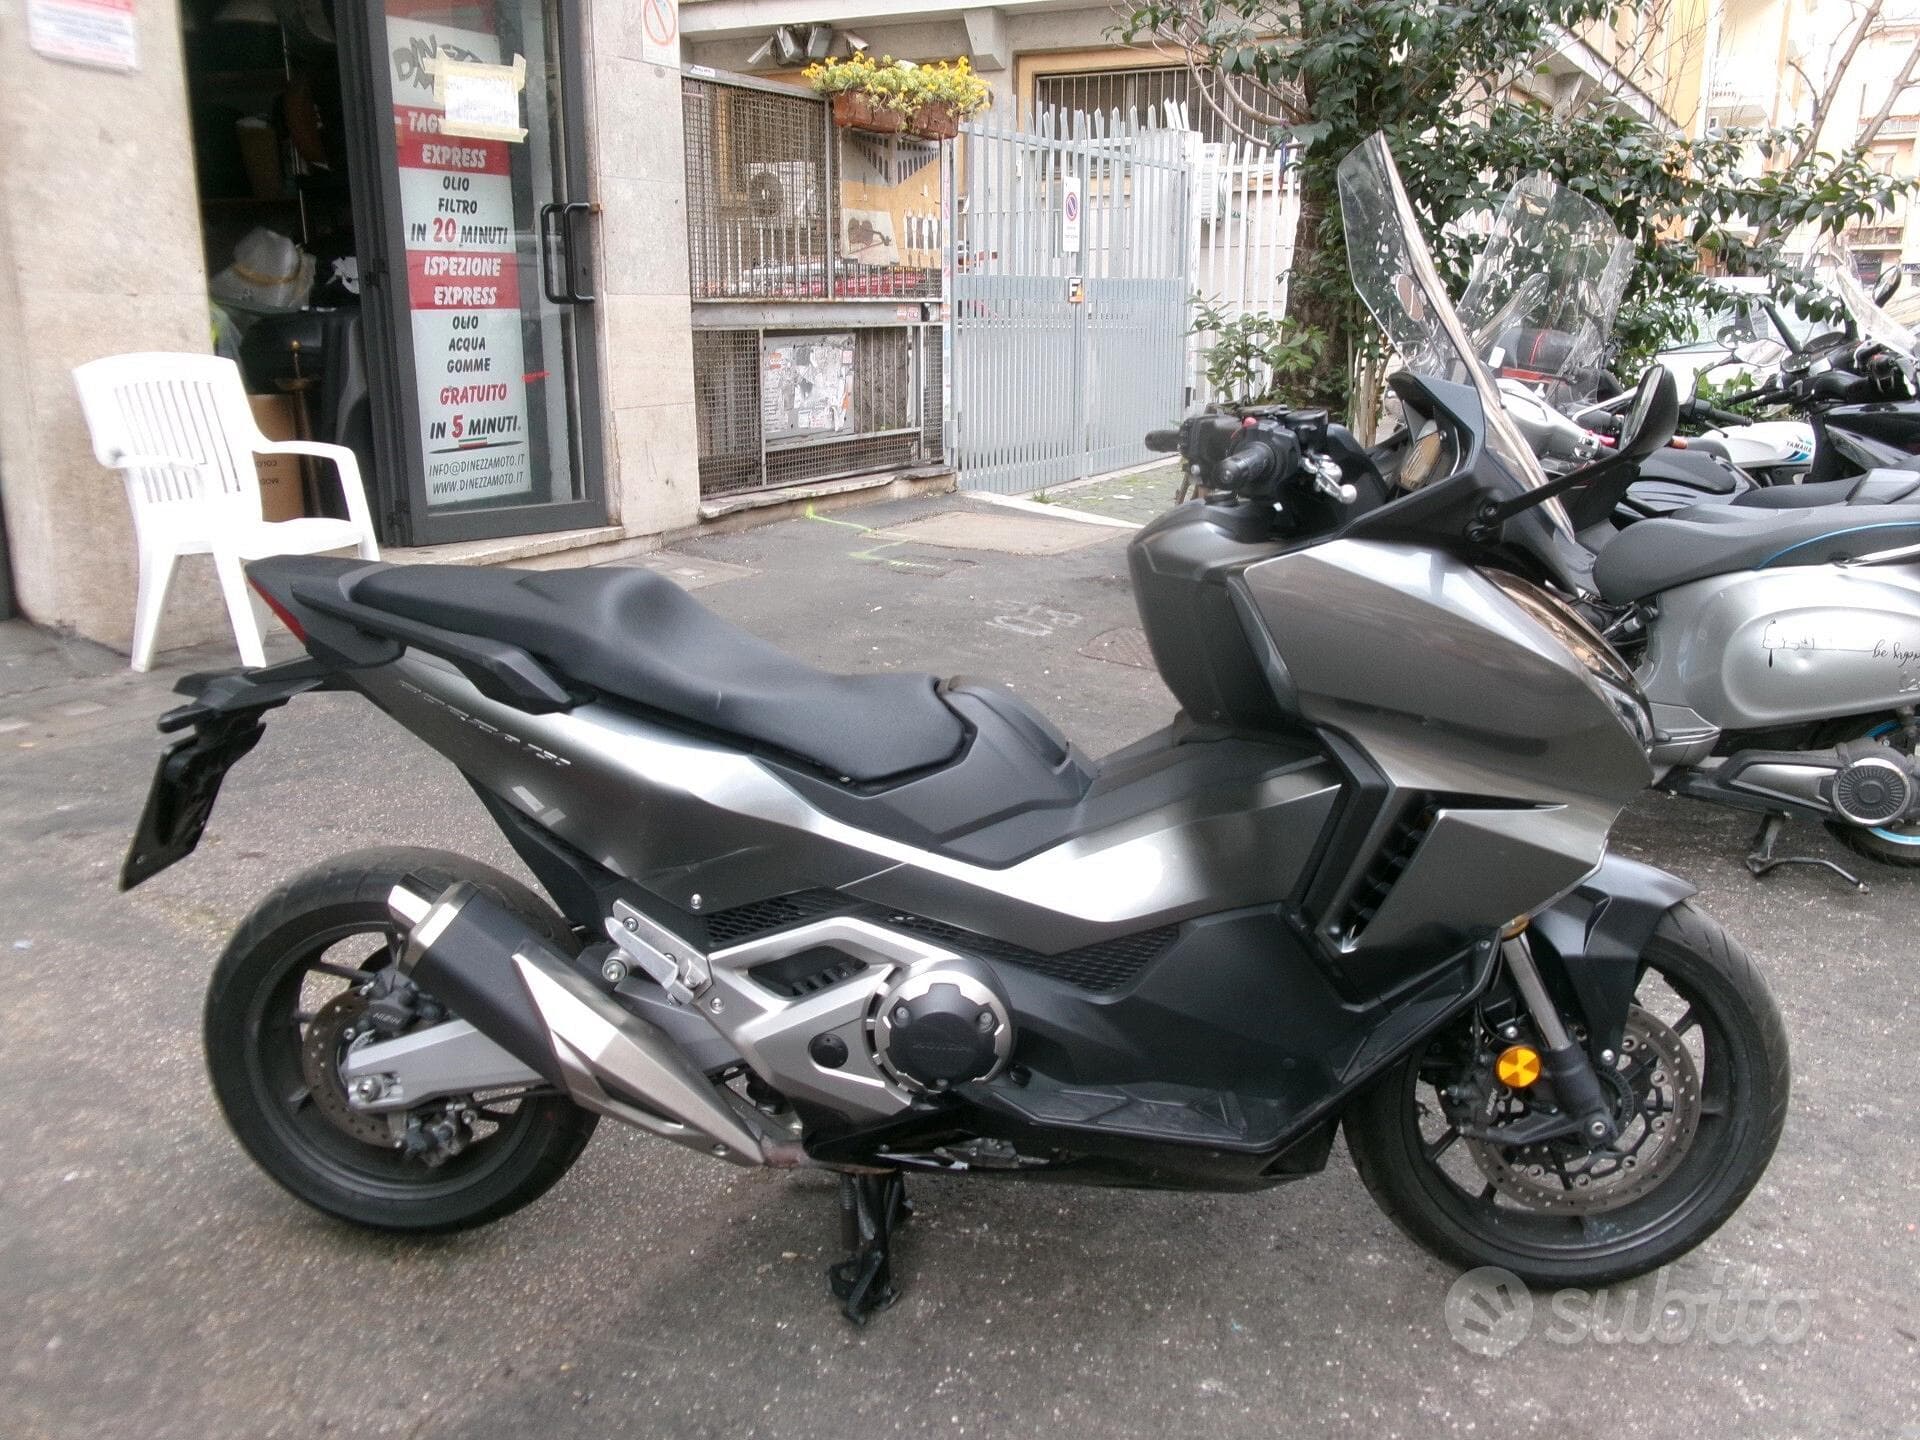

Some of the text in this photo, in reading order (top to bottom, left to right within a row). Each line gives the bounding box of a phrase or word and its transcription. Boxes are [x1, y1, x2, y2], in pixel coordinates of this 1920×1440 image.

[421, 143, 488, 169] EXPRESS
[442, 175, 470, 192] OLIO
[438, 197, 478, 215] FILTRO
[410, 216, 508, 244] IN 20 MINUTI
[423, 255, 502, 277] ISPEZIONE
[433, 285, 498, 307] EXPRESS
[452, 315, 479, 330] OLIO
[448, 337, 486, 352] ACQUA
[446, 358, 491, 373] GOMME
[439, 383, 507, 405] GRATUITO
[429, 421, 446, 440] IN
[451, 414, 464, 438] 5
[1786, 441, 1812, 453] YAMAHA
[428, 453, 525, 477] INFO@DINEZZAMOTO.IT
[432, 471, 524, 495] WWW.DINEZZAMOTO.IT
